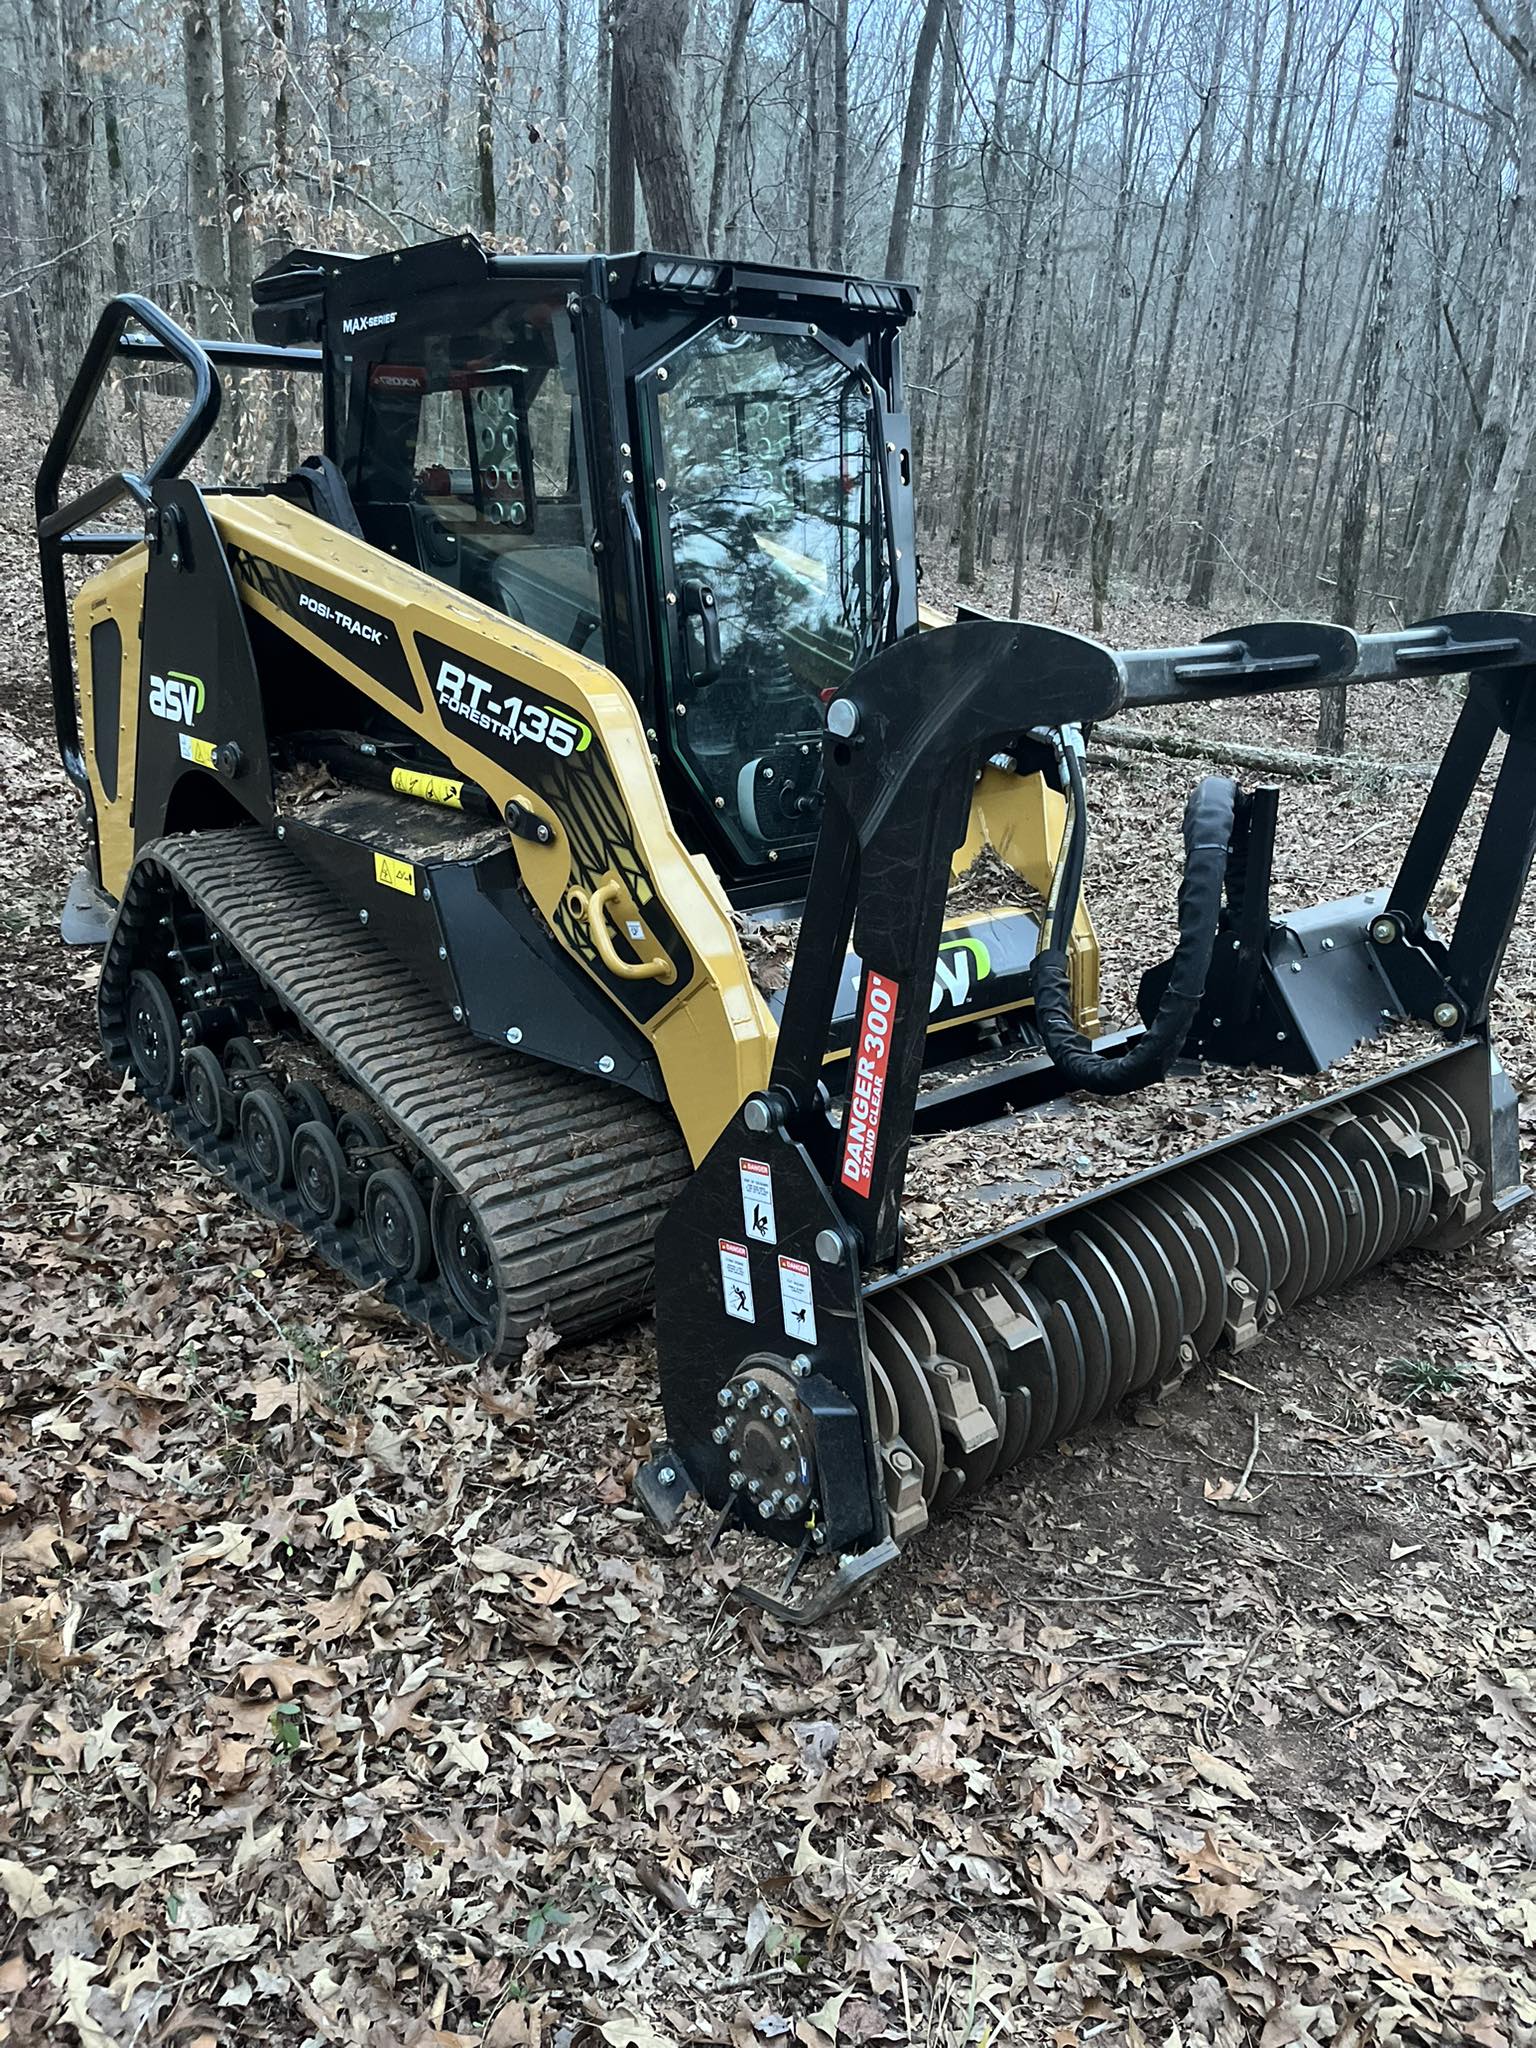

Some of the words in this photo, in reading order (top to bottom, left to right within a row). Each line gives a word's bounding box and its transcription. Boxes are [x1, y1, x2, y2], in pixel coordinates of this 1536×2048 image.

[342, 312, 398, 335] MAX-SERIES
[299, 593, 383, 646] POSI-TRACK
[436, 660, 578, 758] RT-135
[438, 692, 525, 745] FORESTRY
[843, 1056, 877, 1182] DANGER
[868, 1075, 884, 1126] CLEAR
[861, 1128, 877, 1179] STAND
